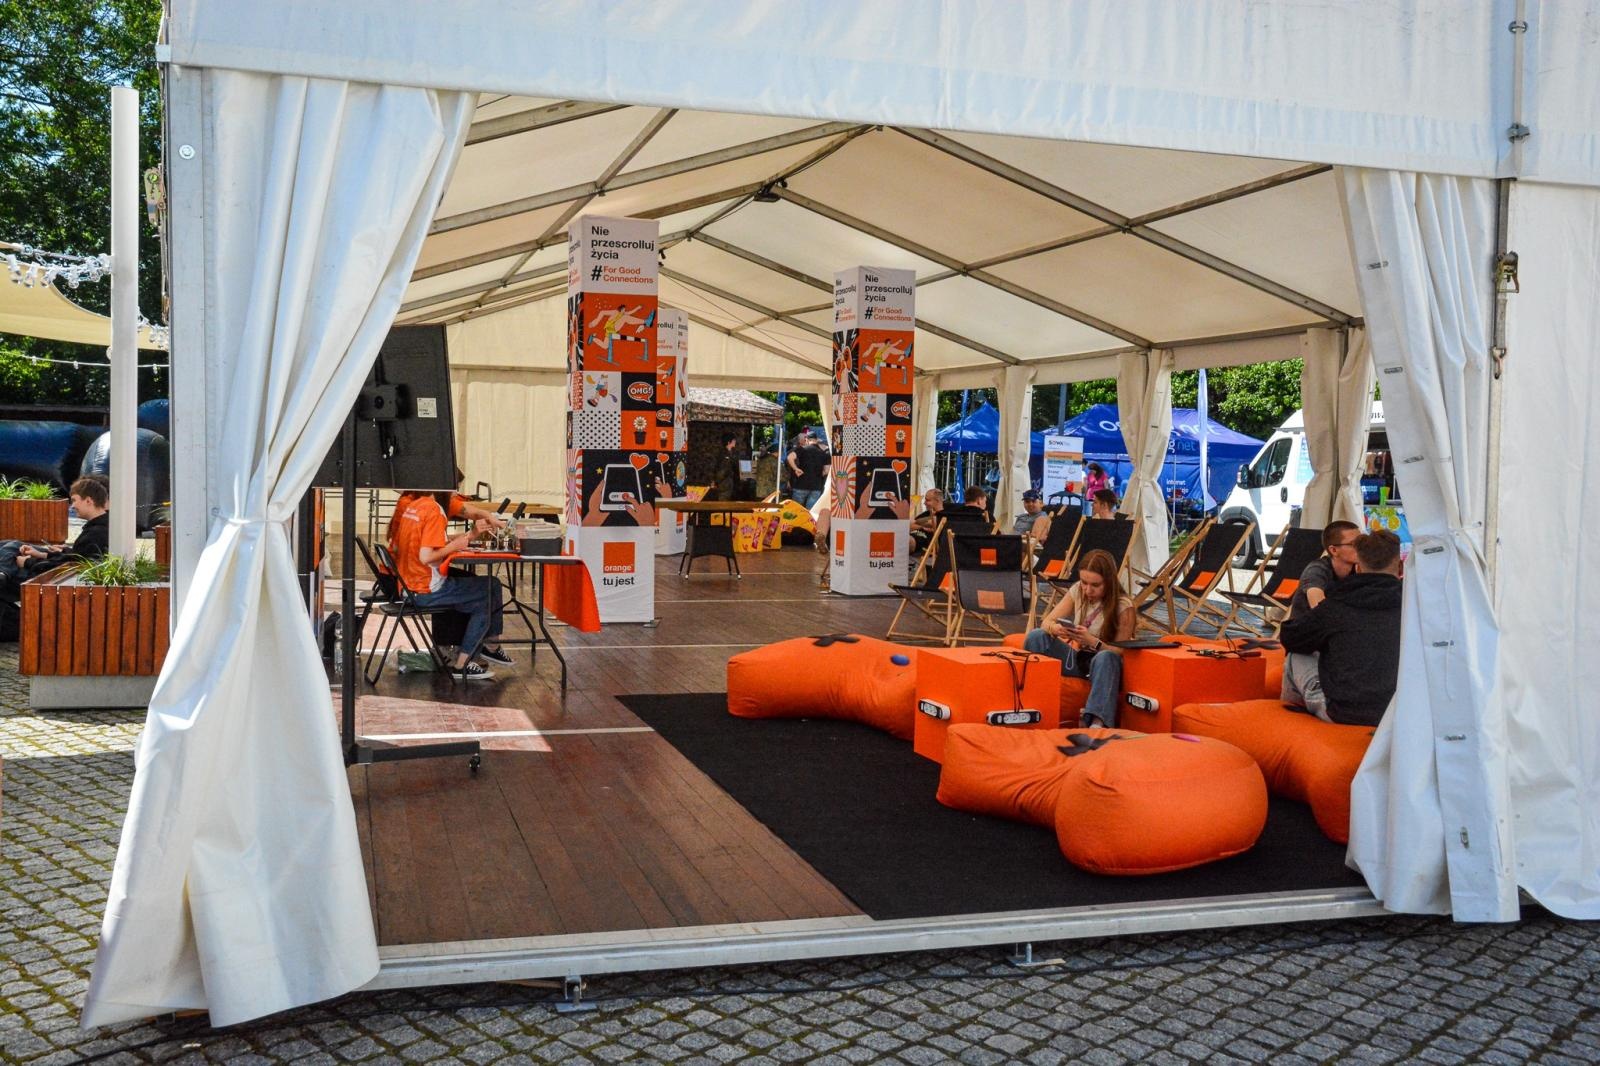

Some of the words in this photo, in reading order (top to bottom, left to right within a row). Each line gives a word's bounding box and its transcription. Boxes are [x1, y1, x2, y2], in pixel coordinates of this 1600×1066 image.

[591, 226, 610, 236] Nie
[591, 239, 655, 251] przescrolluj
[590, 248, 619, 260] życia
[619, 266, 641, 275] Good
[603, 274, 654, 284] Connections
[865, 286, 912, 295] przescrolluj
[865, 294, 886, 302] życia
[630, 387, 652, 395] OMG!
[1177, 440, 1197, 452] net
[604, 565, 632, 573] orange
[869, 560, 878, 568] tu
[878, 560, 895, 569] jest
[603, 576, 614, 586] tu
[614, 576, 635, 587] jest
